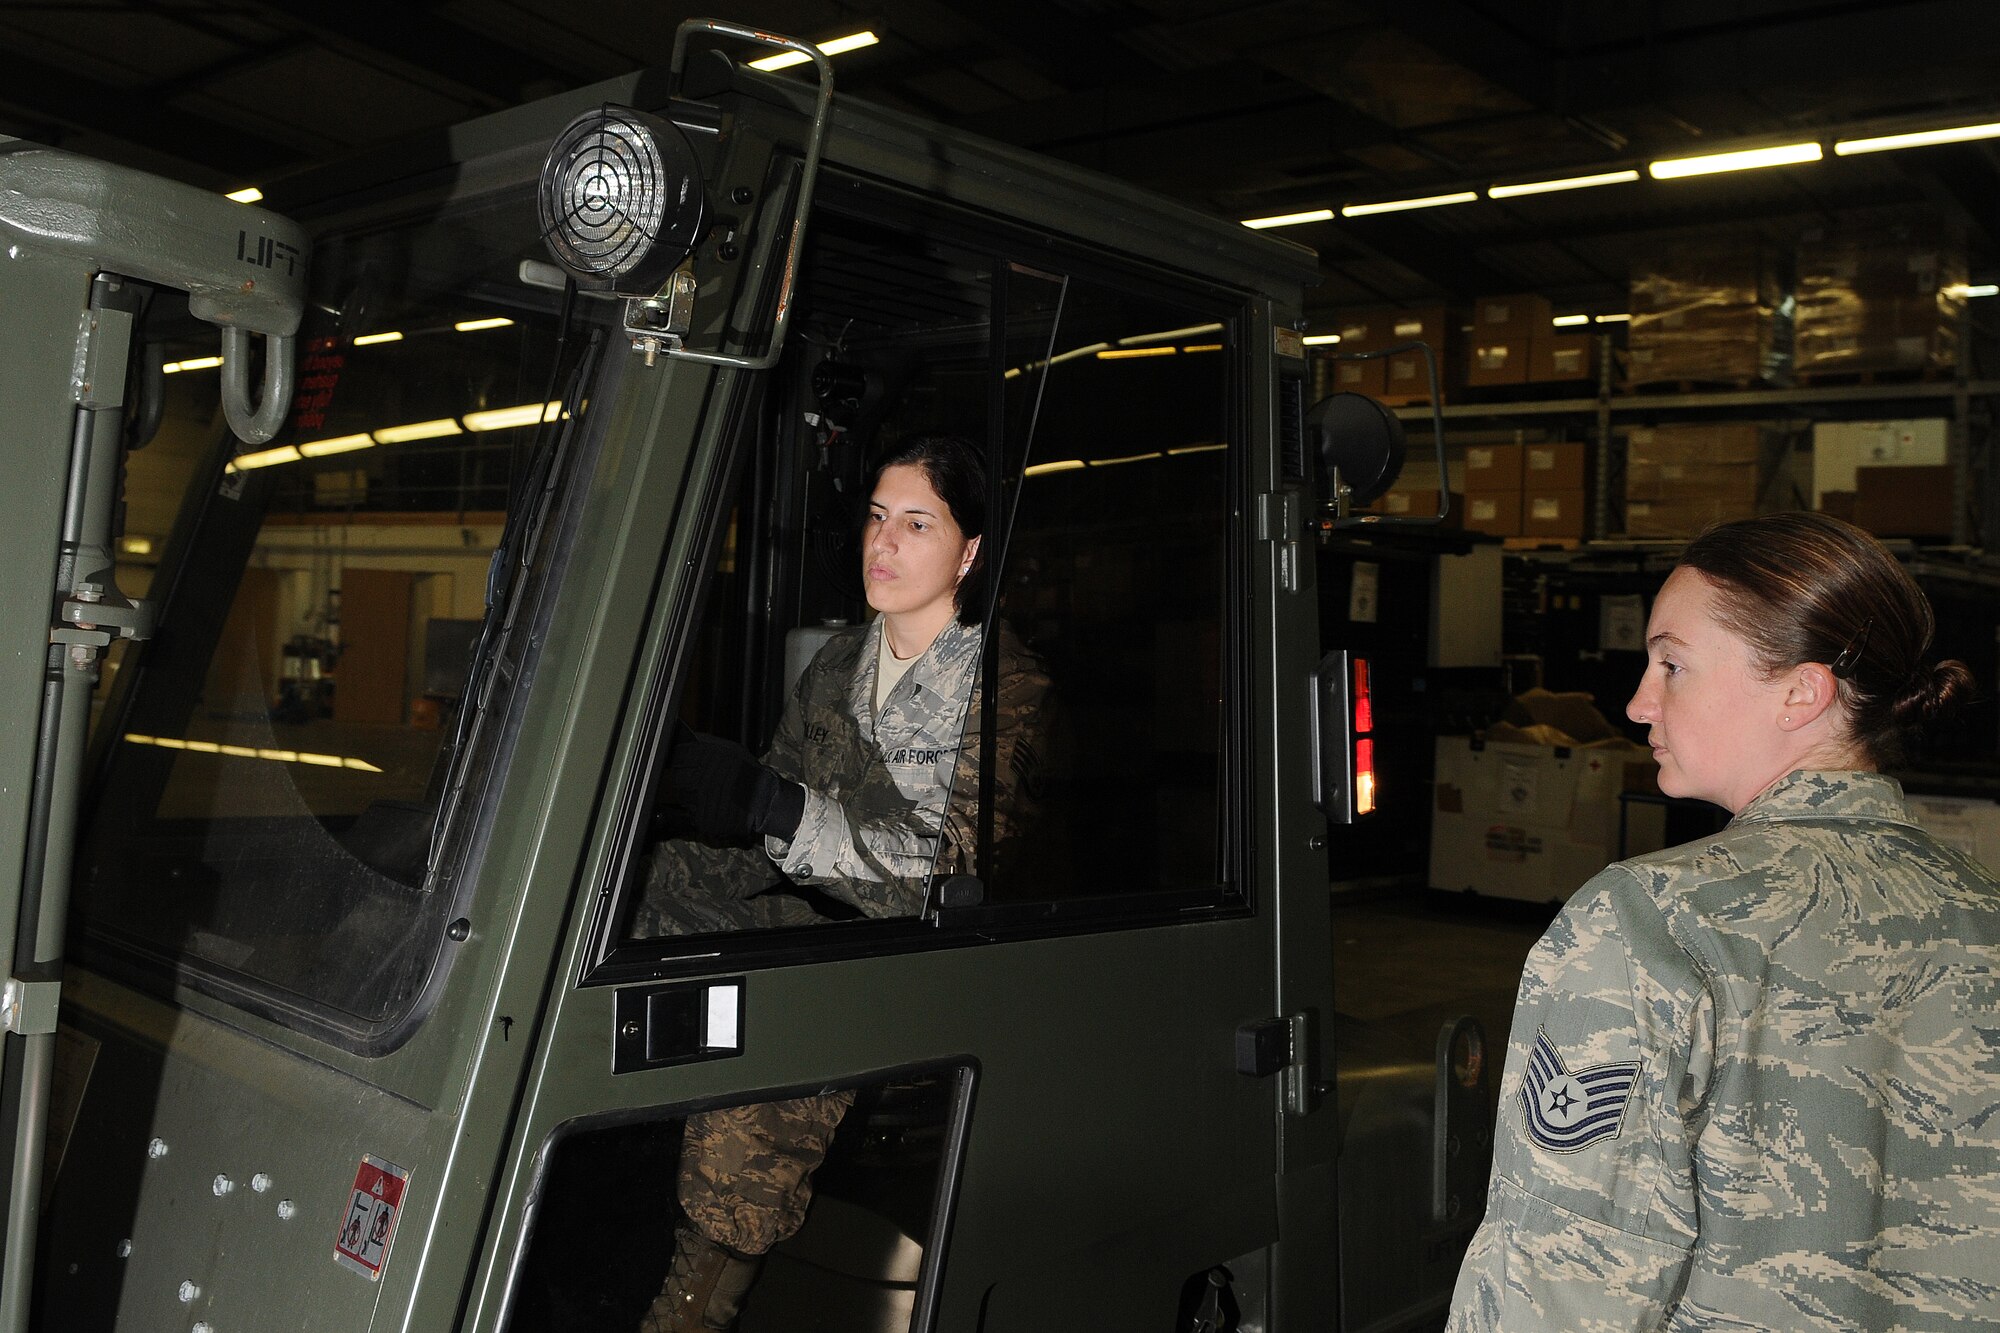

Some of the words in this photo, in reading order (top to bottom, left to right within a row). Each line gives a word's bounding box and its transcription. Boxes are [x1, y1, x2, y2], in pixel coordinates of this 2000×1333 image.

[237, 230, 300, 276] LIFT
[892, 749, 907, 764] AIR
[909, 749, 949, 765] FORC
